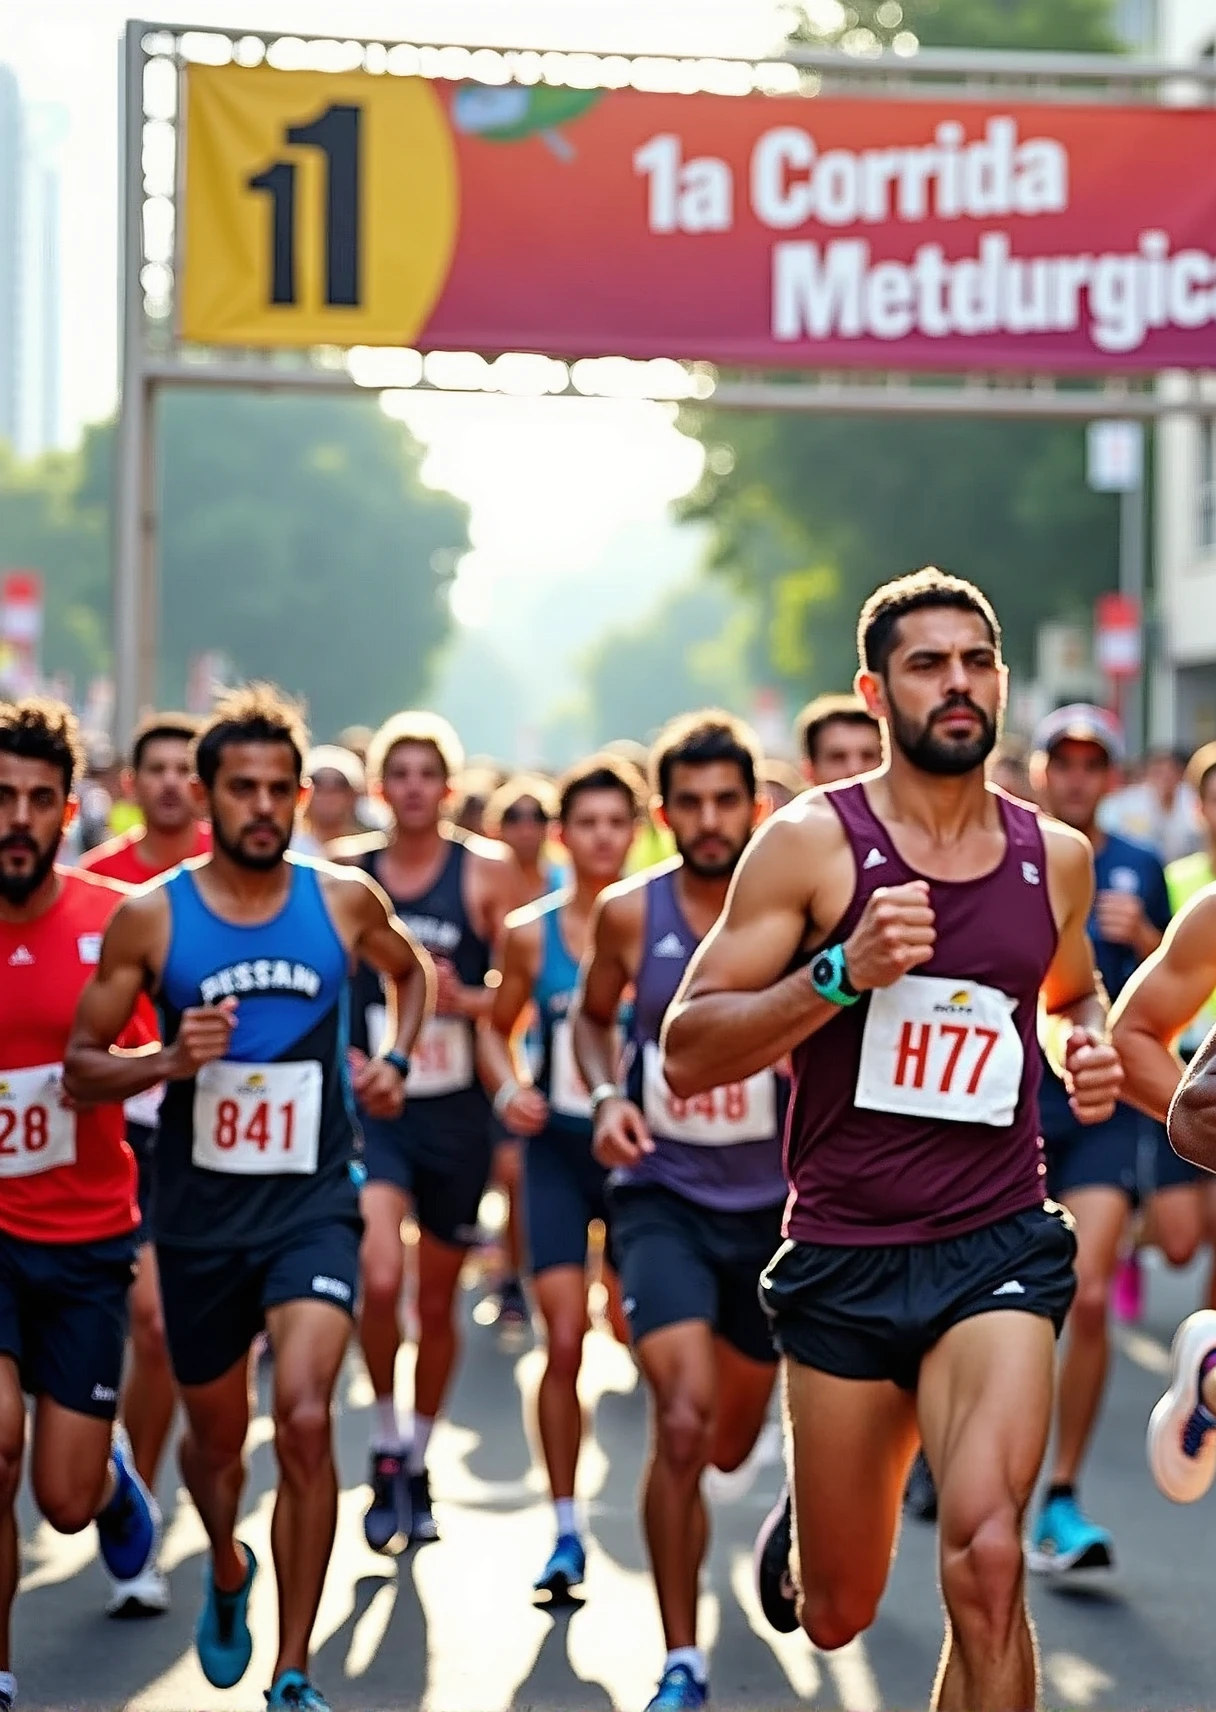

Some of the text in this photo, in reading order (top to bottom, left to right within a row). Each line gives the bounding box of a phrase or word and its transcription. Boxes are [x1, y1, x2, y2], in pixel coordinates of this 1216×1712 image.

[633, 116, 1068, 234] 1a Corrida
[894, 1021, 1000, 1096] H77
[215, 1099, 296, 1151] 841
